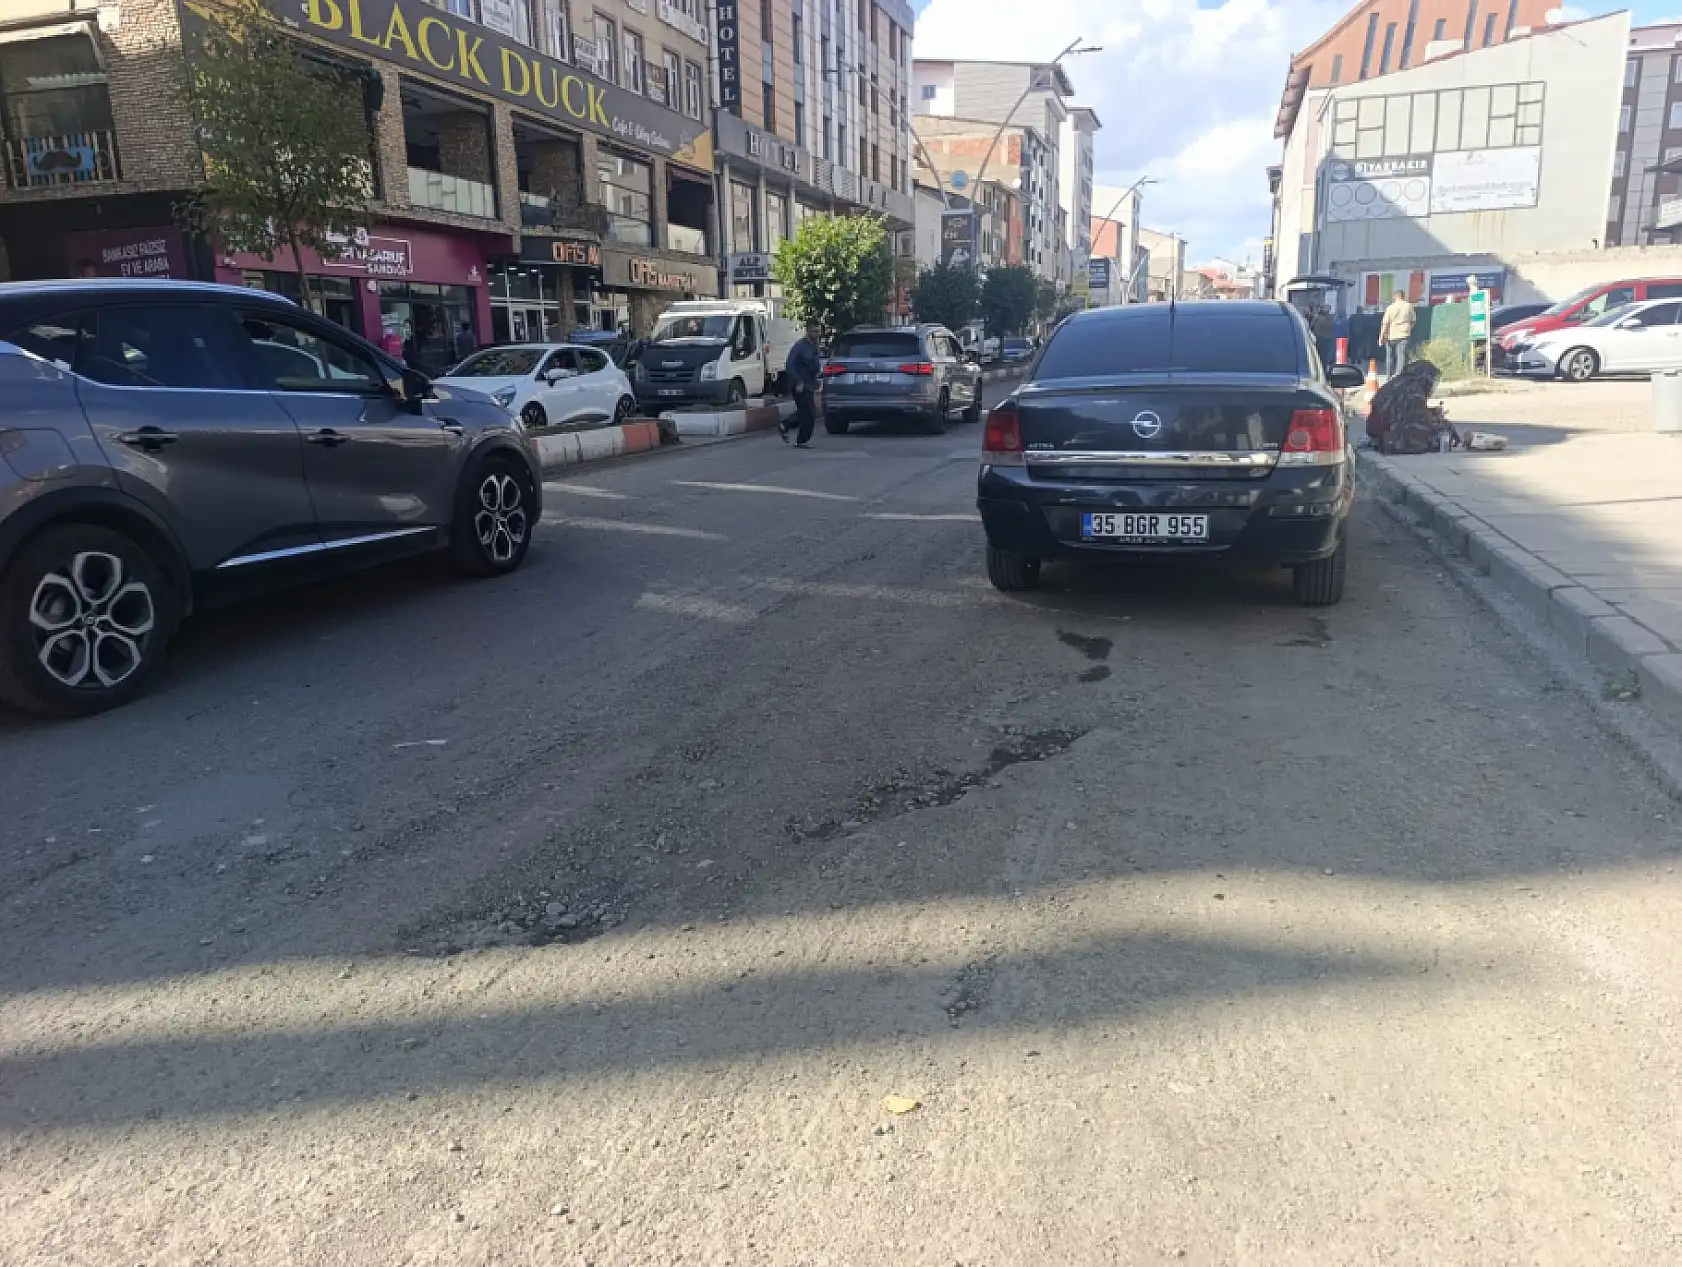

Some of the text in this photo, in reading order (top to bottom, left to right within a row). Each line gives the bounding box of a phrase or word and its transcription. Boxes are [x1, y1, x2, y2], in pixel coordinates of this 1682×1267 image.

[500, 46, 610, 128] DUCK
[719, 6, 736, 101] HOTEL
[1092, 515, 1205, 537] 35 BGR 955
